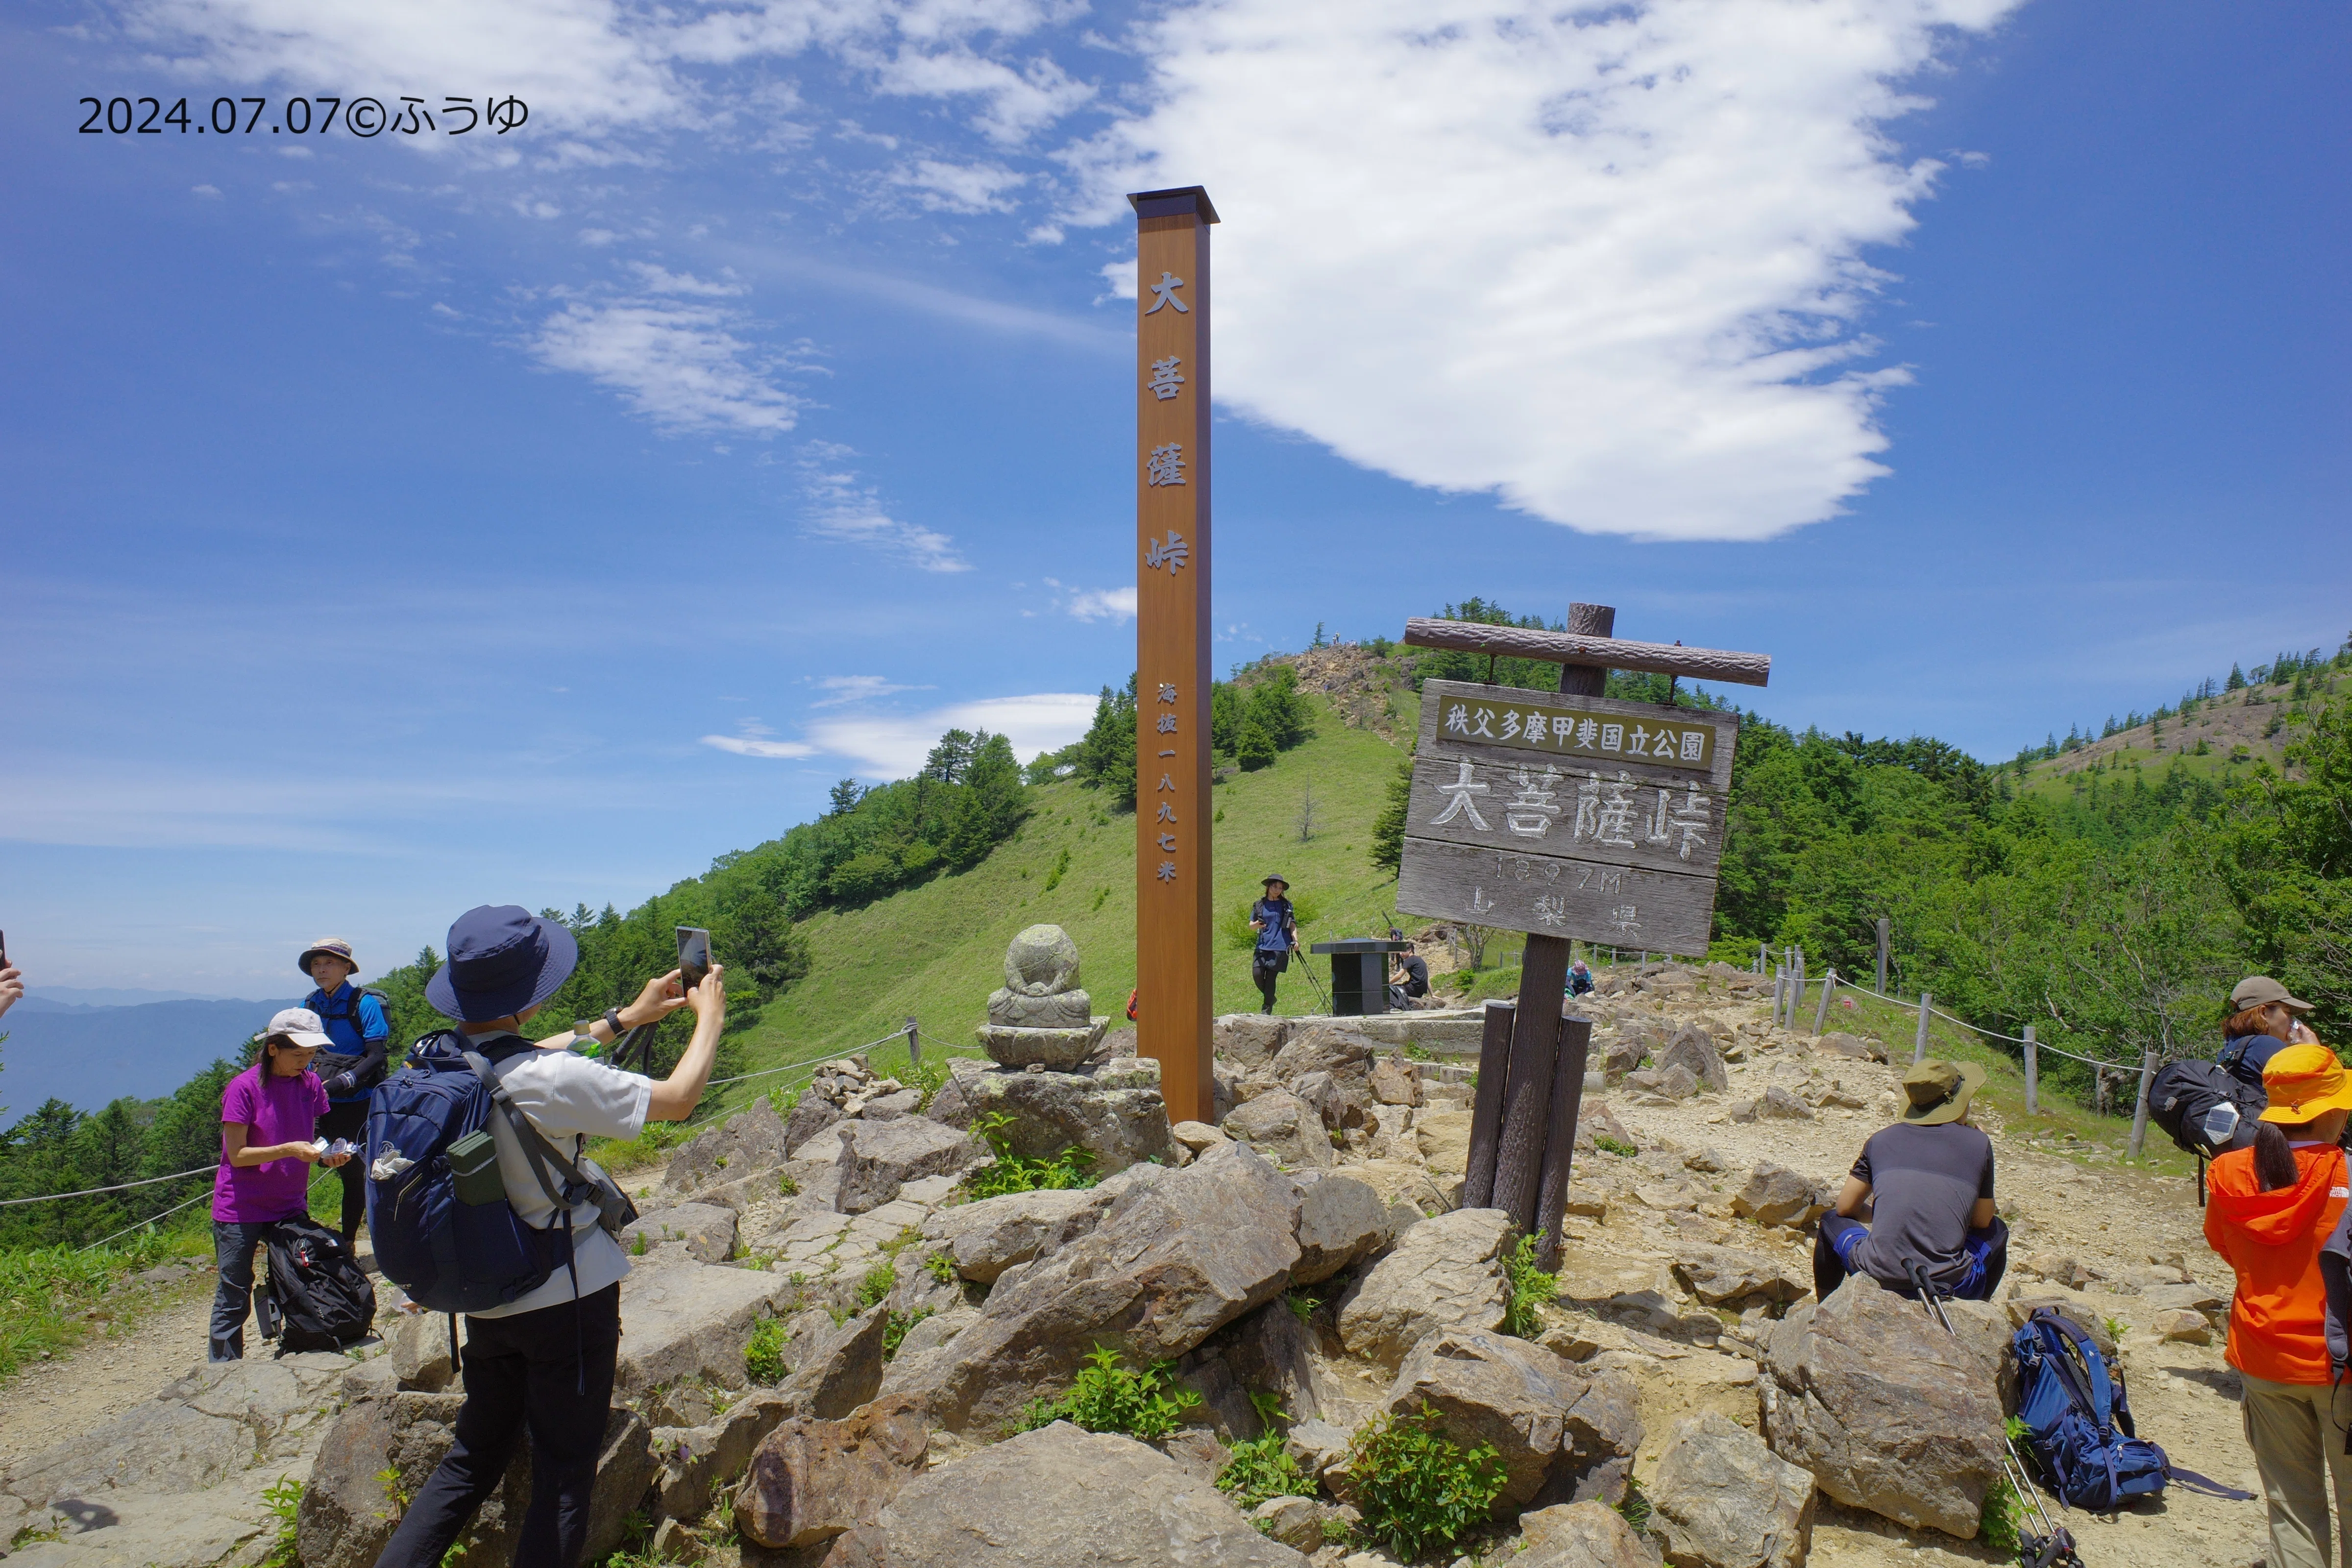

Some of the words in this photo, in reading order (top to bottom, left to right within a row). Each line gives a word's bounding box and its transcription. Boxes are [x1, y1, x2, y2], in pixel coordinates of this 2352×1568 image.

[1145, 271, 1189, 574] 大菩薩峠
[1156, 683, 1177, 883] 海抜一八九七米
[1444, 703, 1705, 761] 秩父多摩甲斐国立公園
[1427, 755, 1712, 861] 大菩薩峠
[1462, 884, 1642, 938] 山梨県
